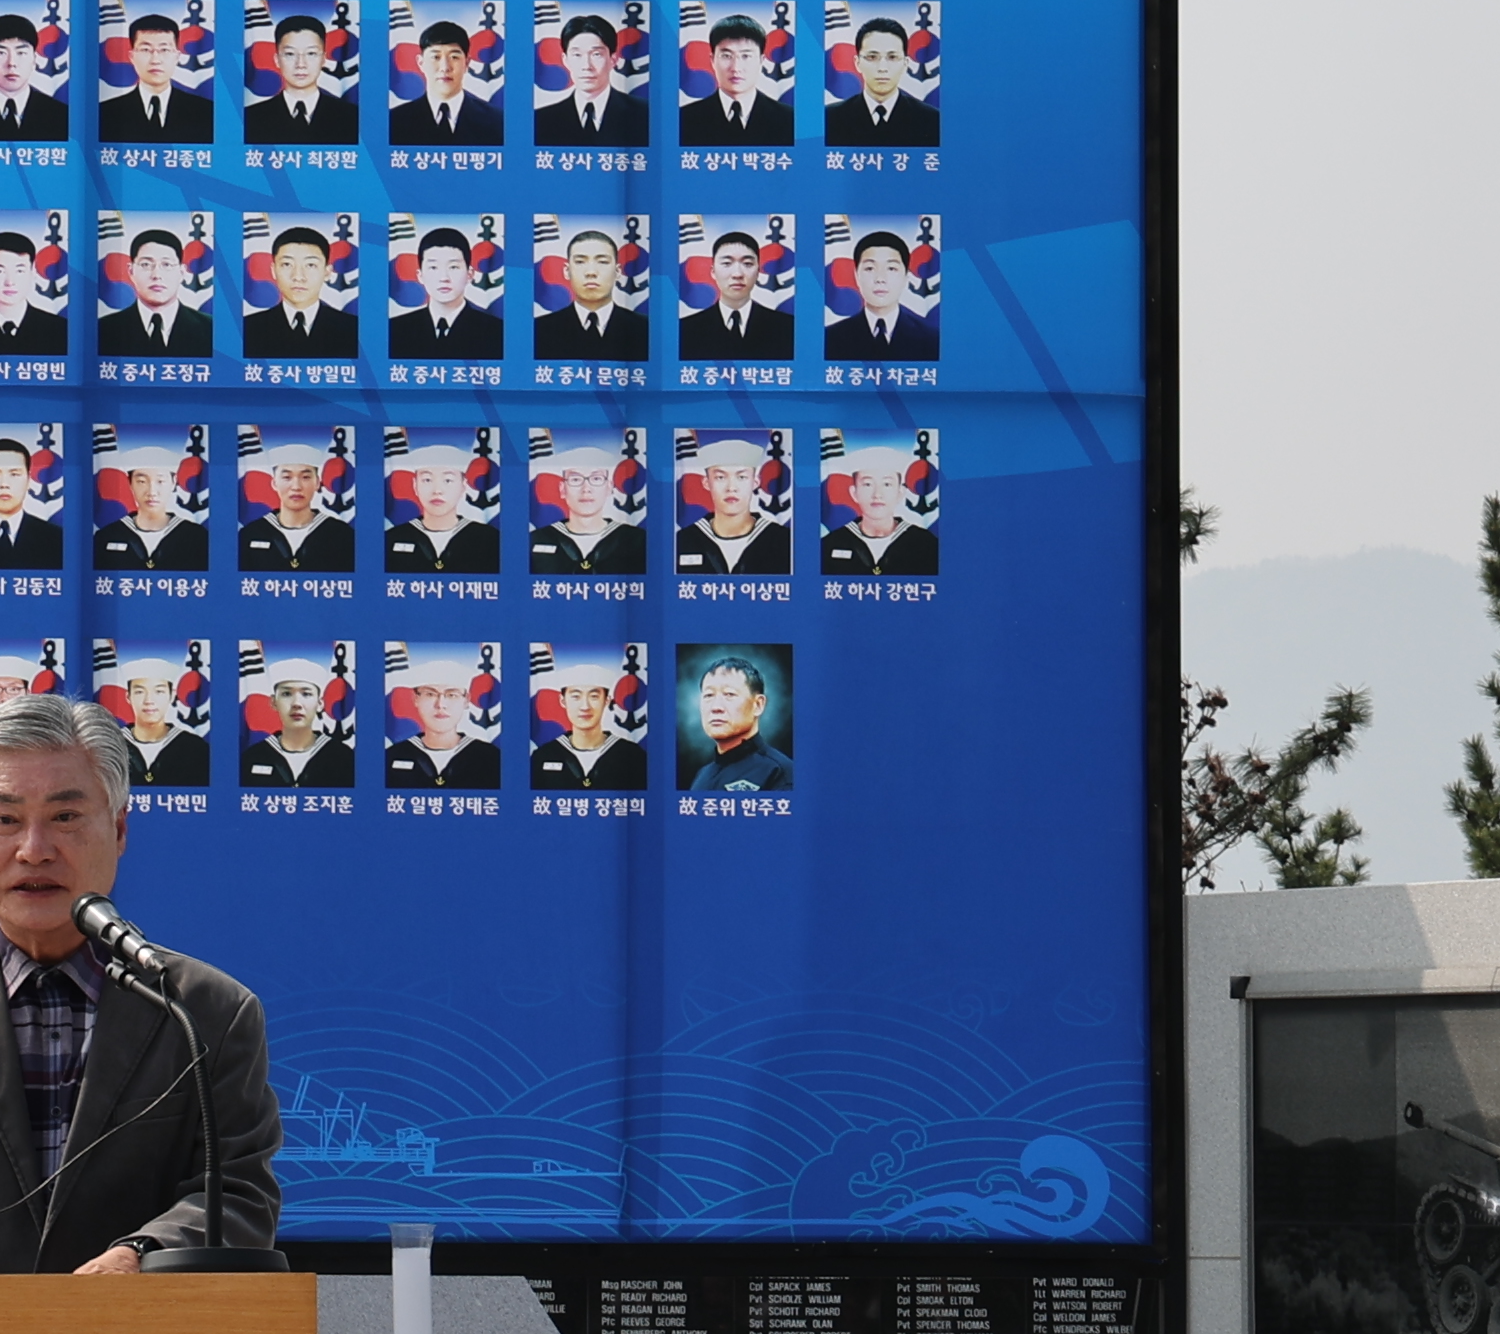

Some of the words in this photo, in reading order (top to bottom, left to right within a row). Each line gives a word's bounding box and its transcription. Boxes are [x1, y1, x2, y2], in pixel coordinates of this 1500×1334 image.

[16, 147, 68, 167] 안경환
[244, 363, 264, 383] 故
[267, 365, 302, 384] 중사
[306, 365, 356, 384] 방일민
[680, 365, 699, 385] 故
[702, 366, 738, 386] 중사
[741, 366, 794, 386] 박보람
[12, 577, 62, 596] 김동진
[824, 581, 843, 600] 故
[847, 582, 882, 601] 하사
[886, 582, 937, 602] 강현구
[678, 796, 698, 816] 故
[701, 798, 736, 817] 준위
[740, 798, 792, 817] 한주호
